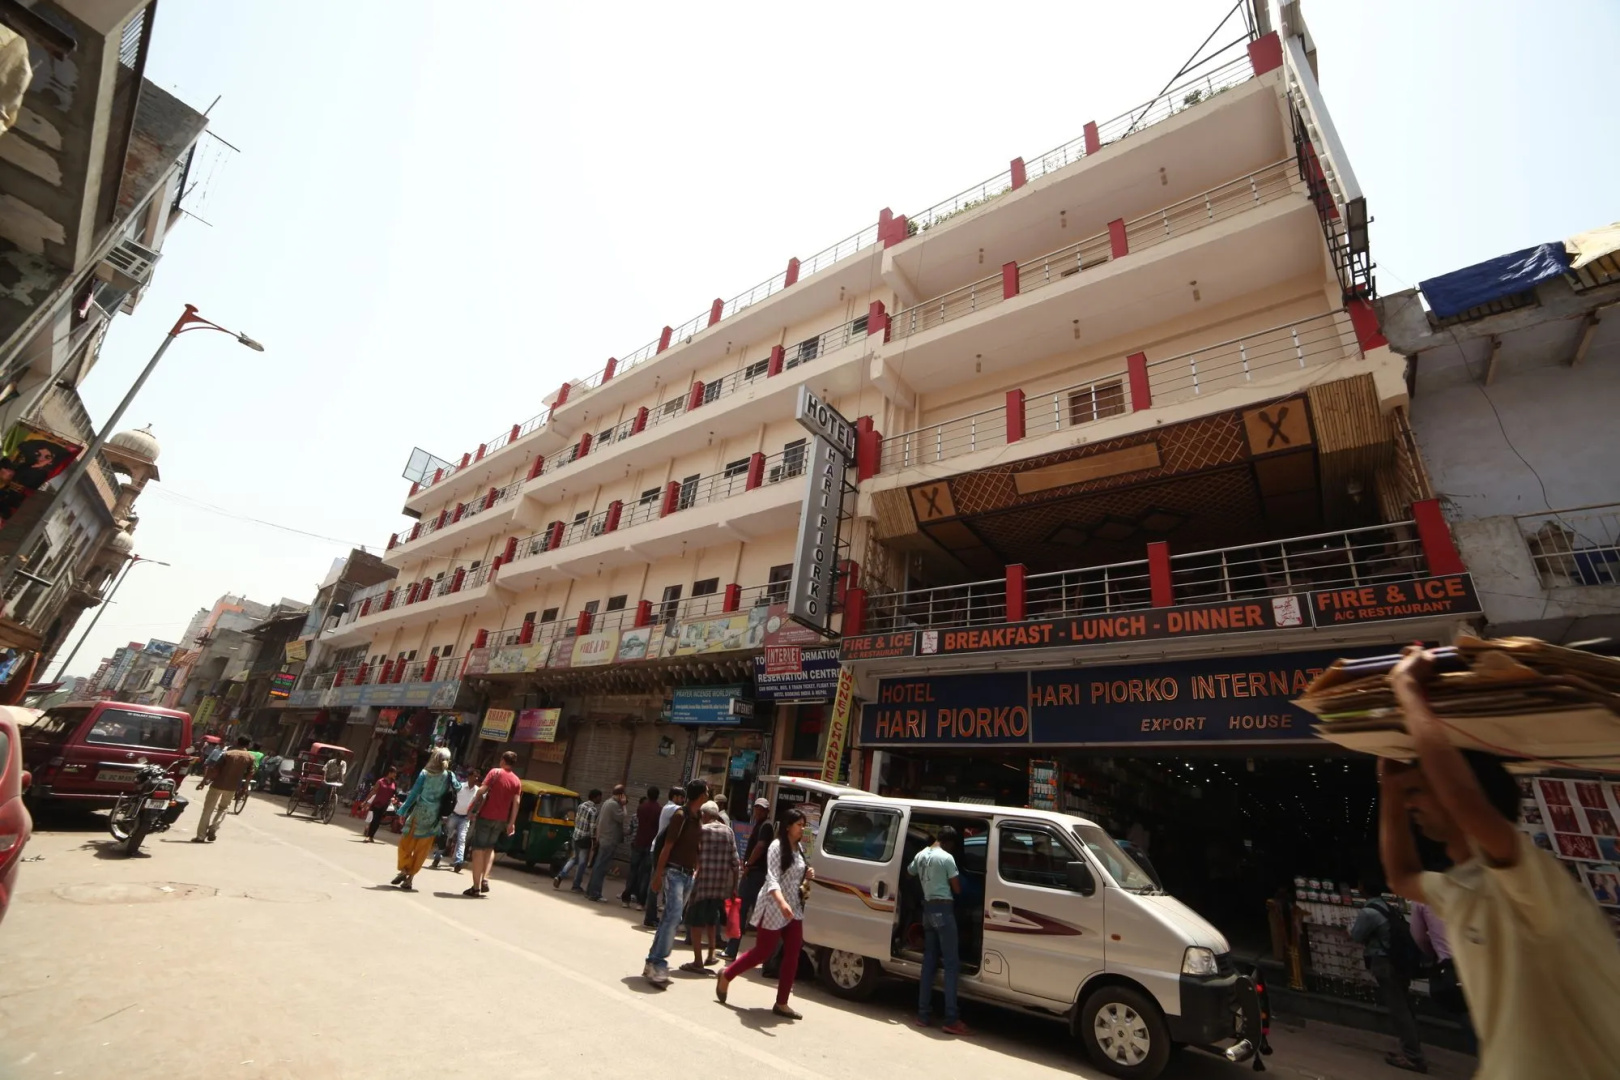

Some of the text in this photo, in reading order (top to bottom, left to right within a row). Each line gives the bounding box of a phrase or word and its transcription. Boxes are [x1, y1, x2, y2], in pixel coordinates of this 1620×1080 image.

[806, 393, 853, 452] HOTEL
[808, 448, 836, 615] HARI PIORKO
[1316, 577, 1466, 611] FIRE & ICE
[1334, 600, 1453, 621] A/C RESTAURANT
[944, 624, 1053, 650] BREAKFAST
[1071, 615, 1146, 640] LUNCH
[1167, 604, 1265, 633] DINNER
[843, 633, 914, 651] FIRE & ICE
[767, 647, 800, 662] INTERNET
[802, 649, 840, 661] ORMATION
[859, 648, 904, 658] RESTAURANT
[758, 671, 808, 683] RESERVATION
[1029, 667, 1324, 707] HARI PIORKO INTERNAT
[882, 683, 936, 703] HOTEL
[825, 669, 853, 783] MONEY CHANGE
[875, 706, 1028, 738] HARI PIORKO
[1141, 714, 1293, 732] EXPORT HOUSE
